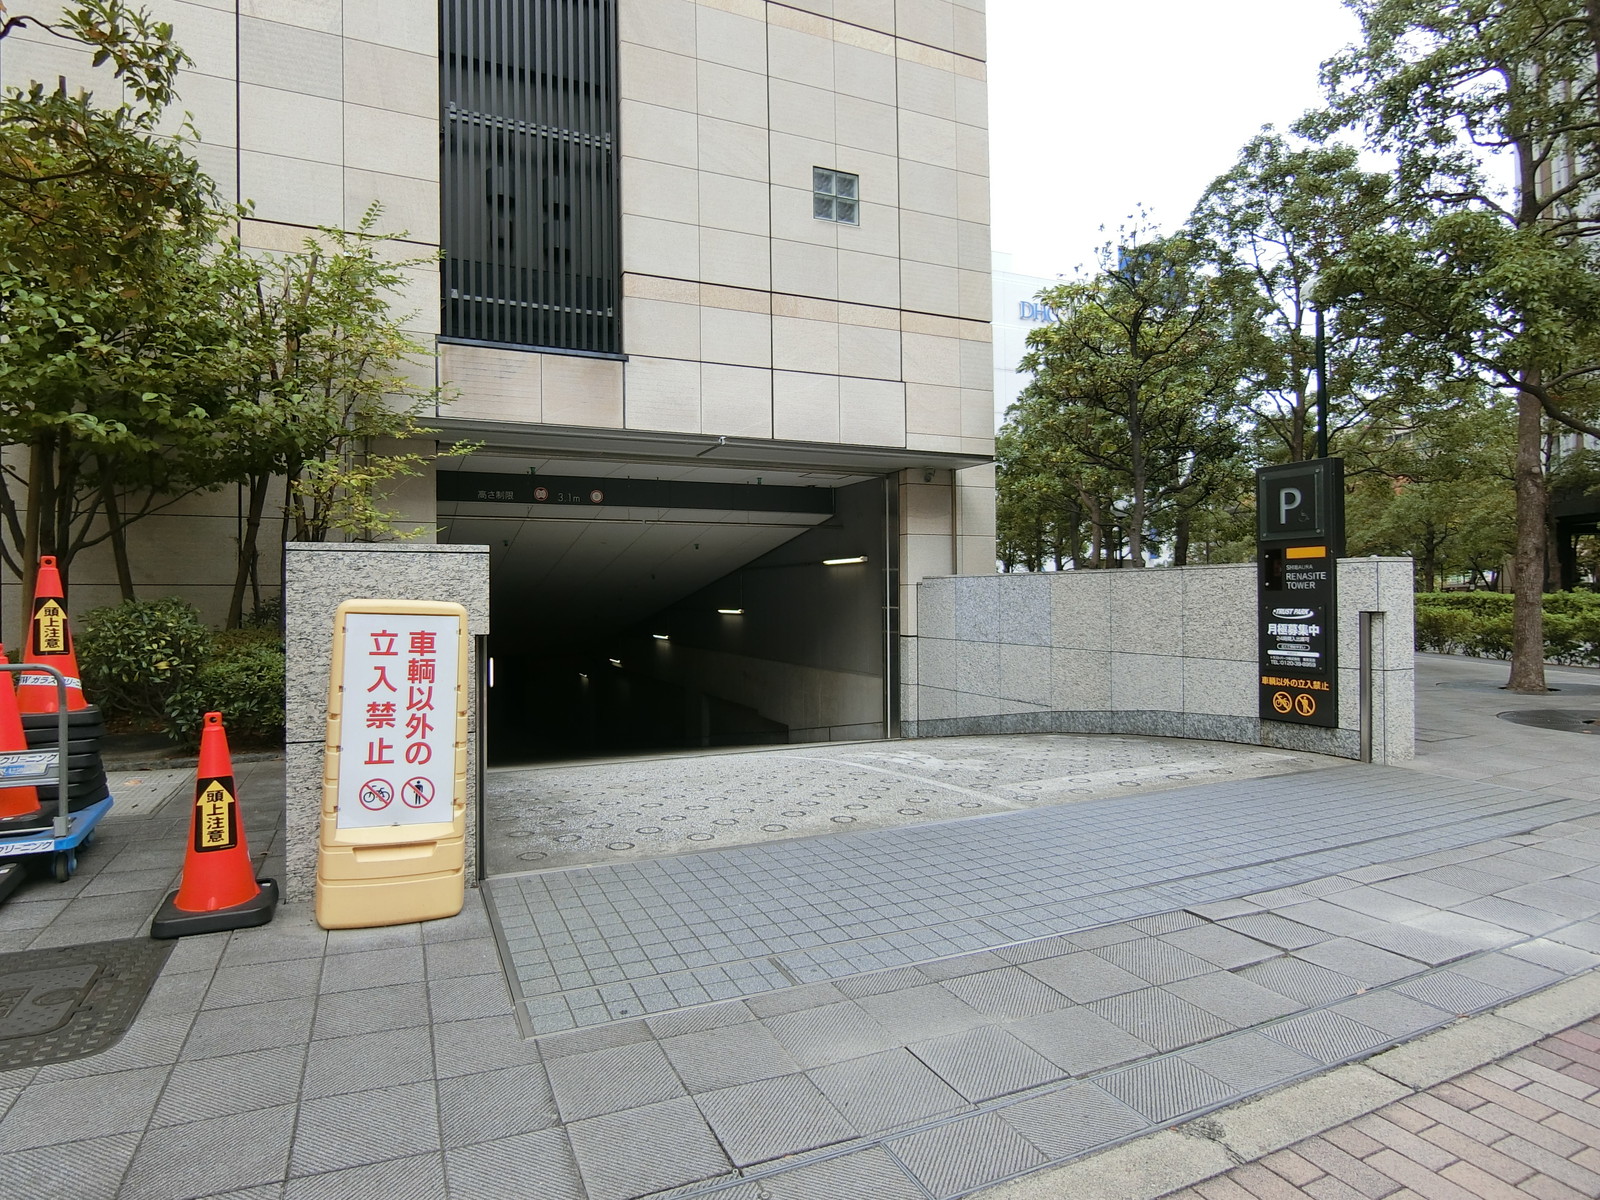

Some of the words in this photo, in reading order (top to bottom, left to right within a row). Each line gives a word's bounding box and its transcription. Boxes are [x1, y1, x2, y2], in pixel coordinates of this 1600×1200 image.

[477, 490, 515, 500] 高さ制限
[557, 492, 581, 503] 3.1m
[1279, 487, 1302, 525] P
[1285, 563, 1313, 571] SHIBAURA
[1285, 571, 1327, 581] RENASITE
[1286, 581, 1316, 590] TOWER
[44, 606, 60, 649] 頭上注意
[1267, 623, 1320, 637] 月極募集中
[364, 629, 399, 766] 立入禁止
[405, 630, 437, 766] 車輌以外の
[206, 789, 225, 843] 頭上注意
